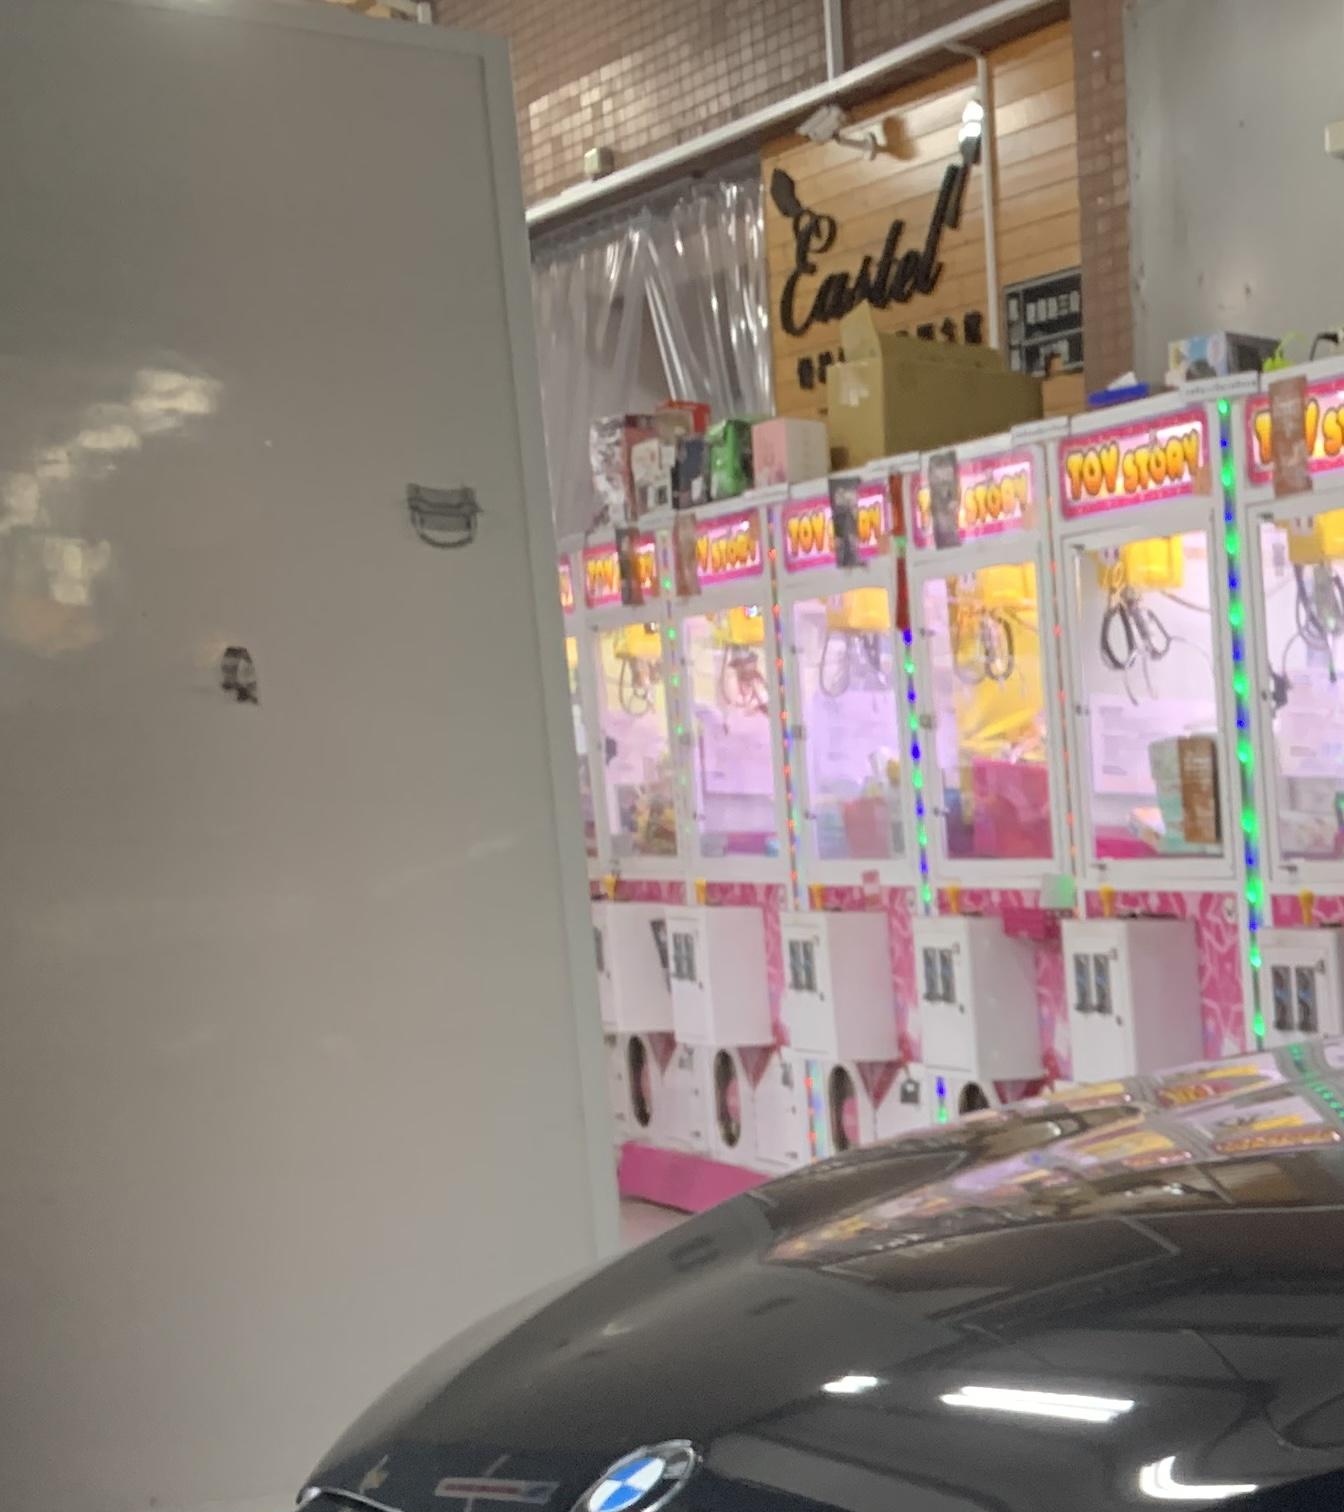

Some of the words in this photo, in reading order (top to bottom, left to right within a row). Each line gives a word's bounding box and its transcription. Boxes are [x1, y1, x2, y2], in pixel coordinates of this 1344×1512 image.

[1254, 398, 1320, 464] TY
[1066, 440, 1121, 501] TOY
[1122, 428, 1200, 494] STORY
[964, 470, 1029, 525] STORY
[788, 508, 826, 556] TOY
